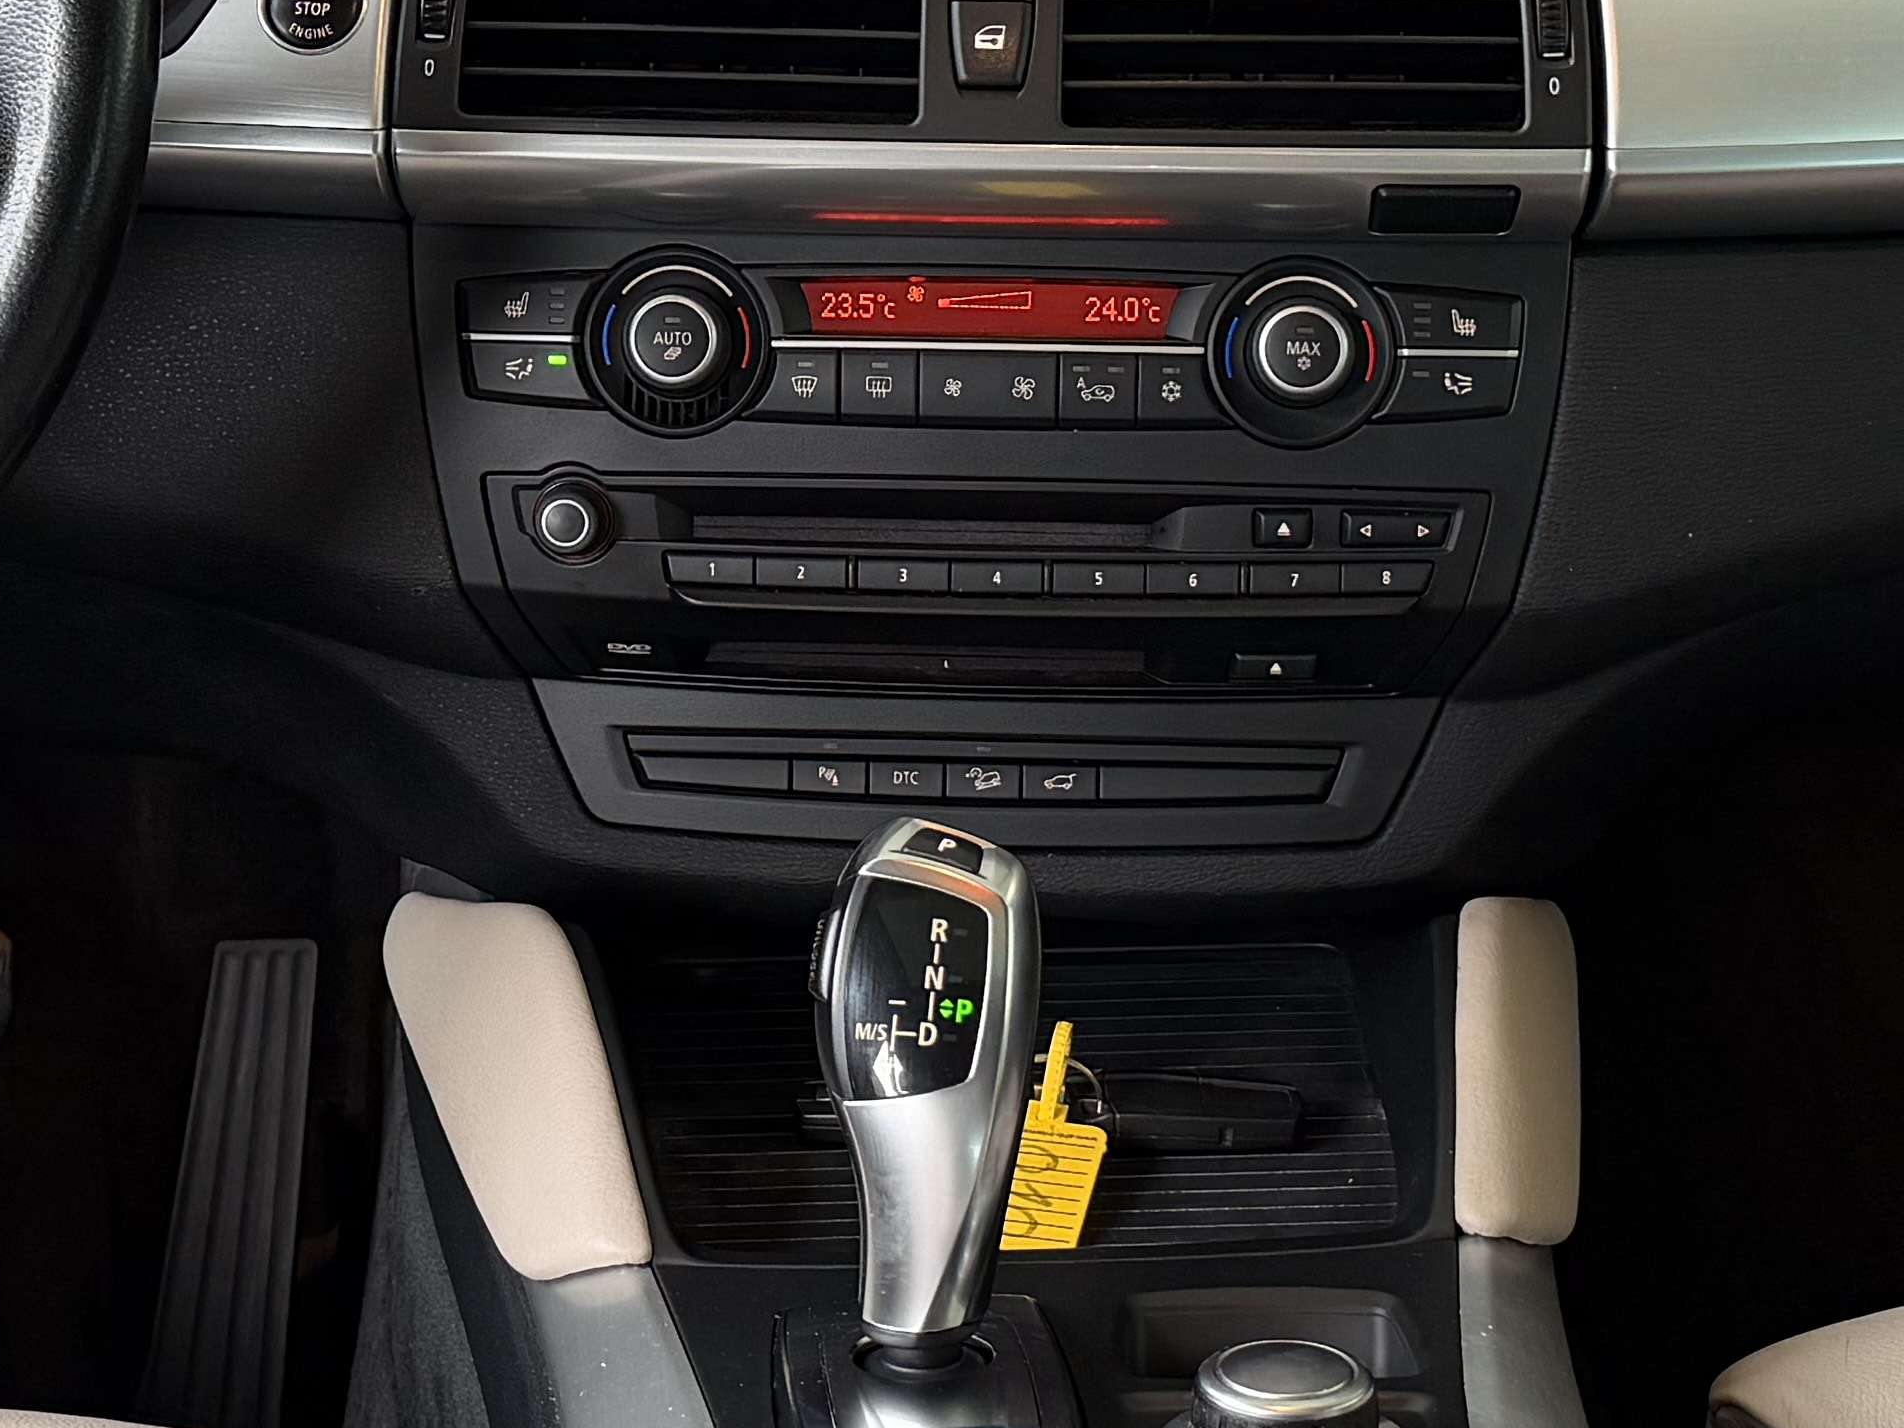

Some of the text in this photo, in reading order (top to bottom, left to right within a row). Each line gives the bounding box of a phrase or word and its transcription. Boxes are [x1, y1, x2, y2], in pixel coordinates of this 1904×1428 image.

[295, 1, 330, 16] STOP
[288, 22, 334, 39] ENGINE
[653, 331, 692, 346] AUTO
[1286, 341, 1321, 356] MAX
[709, 562, 716, 577] 1
[797, 566, 805, 580] 2
[899, 568, 908, 583] 3
[992, 571, 1001, 585] 4
[1095, 572, 1103, 586] 5
[1189, 573, 1198, 587] 6
[1291, 573, 1299, 588] 7
[1381, 570, 1391, 585] 8
[893, 771, 919, 785] DTC
[937, 838, 957, 852] P
[930, 918, 948, 942] R
[924, 965, 944, 990] N
[955, 999, 973, 1023] P
[855, 1022, 888, 1041] M/S
[918, 1022, 938, 1046] D
